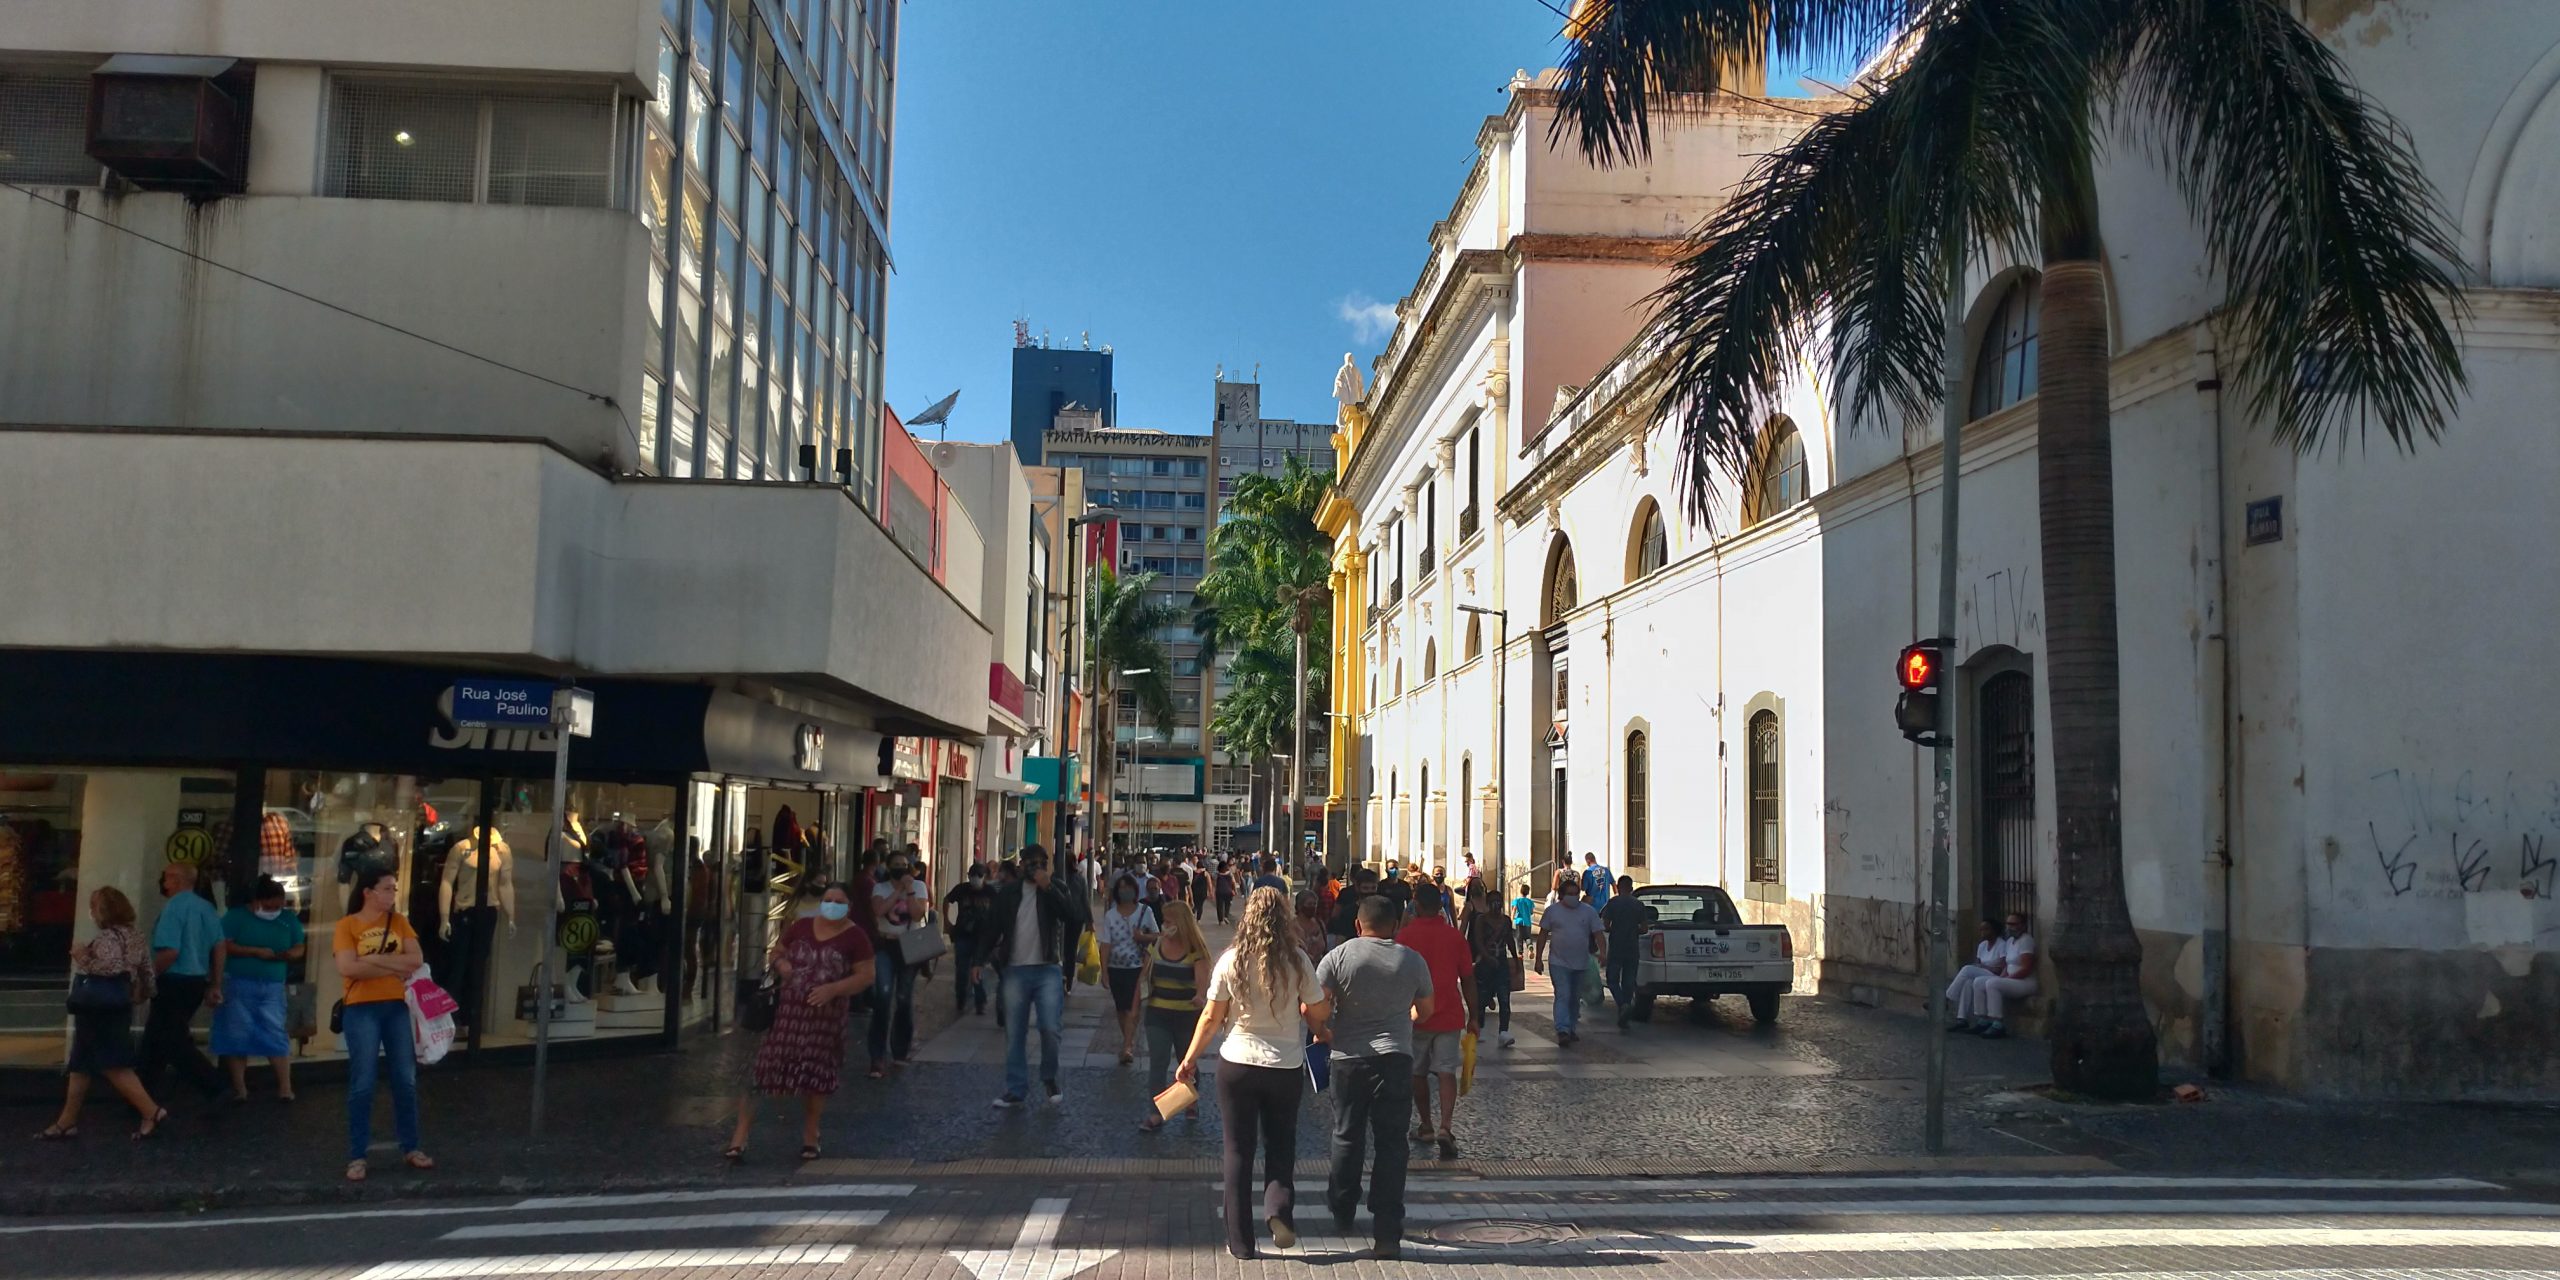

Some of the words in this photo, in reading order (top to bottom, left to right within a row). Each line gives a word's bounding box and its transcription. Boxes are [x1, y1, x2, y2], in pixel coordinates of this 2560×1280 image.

[462, 687, 490, 700] Rua
[494, 688, 527, 701] José
[497, 703, 548, 716] Paulino
[460, 719, 487, 728] Centro
[173, 833, 205, 861] 80
[567, 921, 592, 945] 80
[1685, 946, 1718, 954] SETEC
